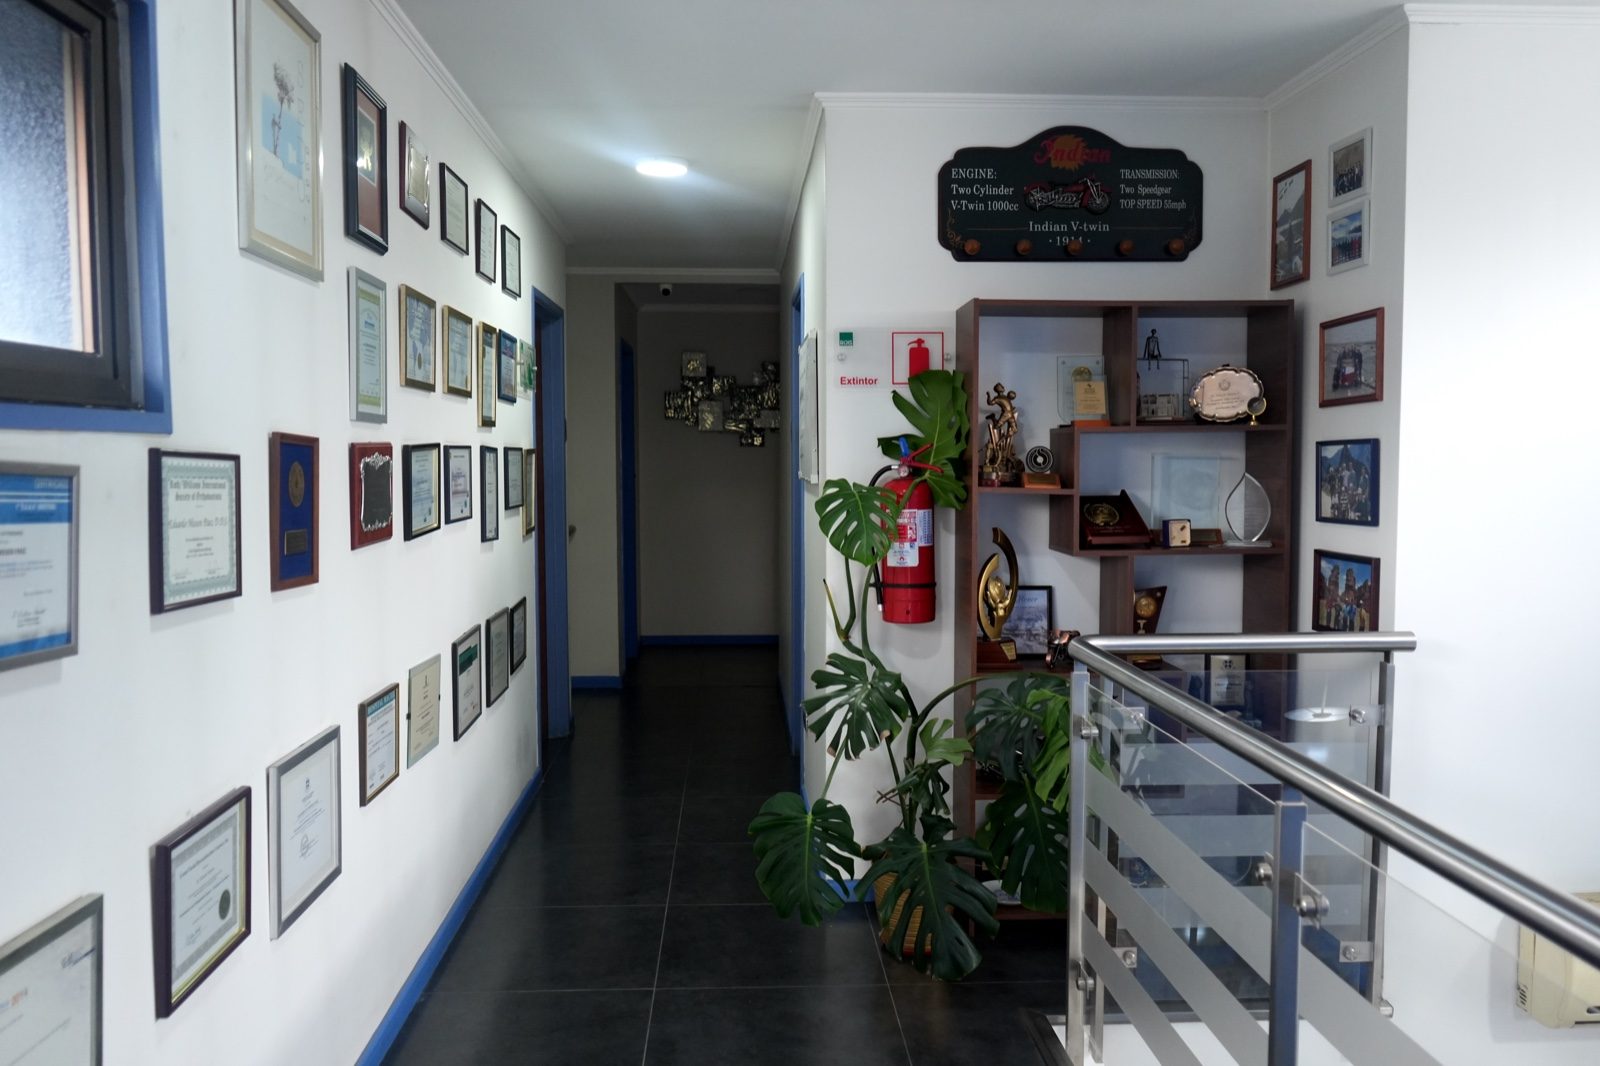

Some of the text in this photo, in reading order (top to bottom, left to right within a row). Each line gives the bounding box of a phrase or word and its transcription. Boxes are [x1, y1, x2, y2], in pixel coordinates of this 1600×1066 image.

[1033, 137, 1112, 165] Indian
[951, 168, 997, 179] ENGINE:
[1119, 168, 1180, 179] TRANSMISSION:
[951, 184, 1014, 197] Two Cylinder
[1119, 184, 1172, 196] Two Speedgear
[951, 200, 1019, 211] V-Twin 1000cc
[1119, 199, 1136, 209] TOP
[1137, 199, 1163, 209] SPEED
[1029, 221, 1110, 232] Indian V-twin
[840, 376, 878, 385] Extintor
